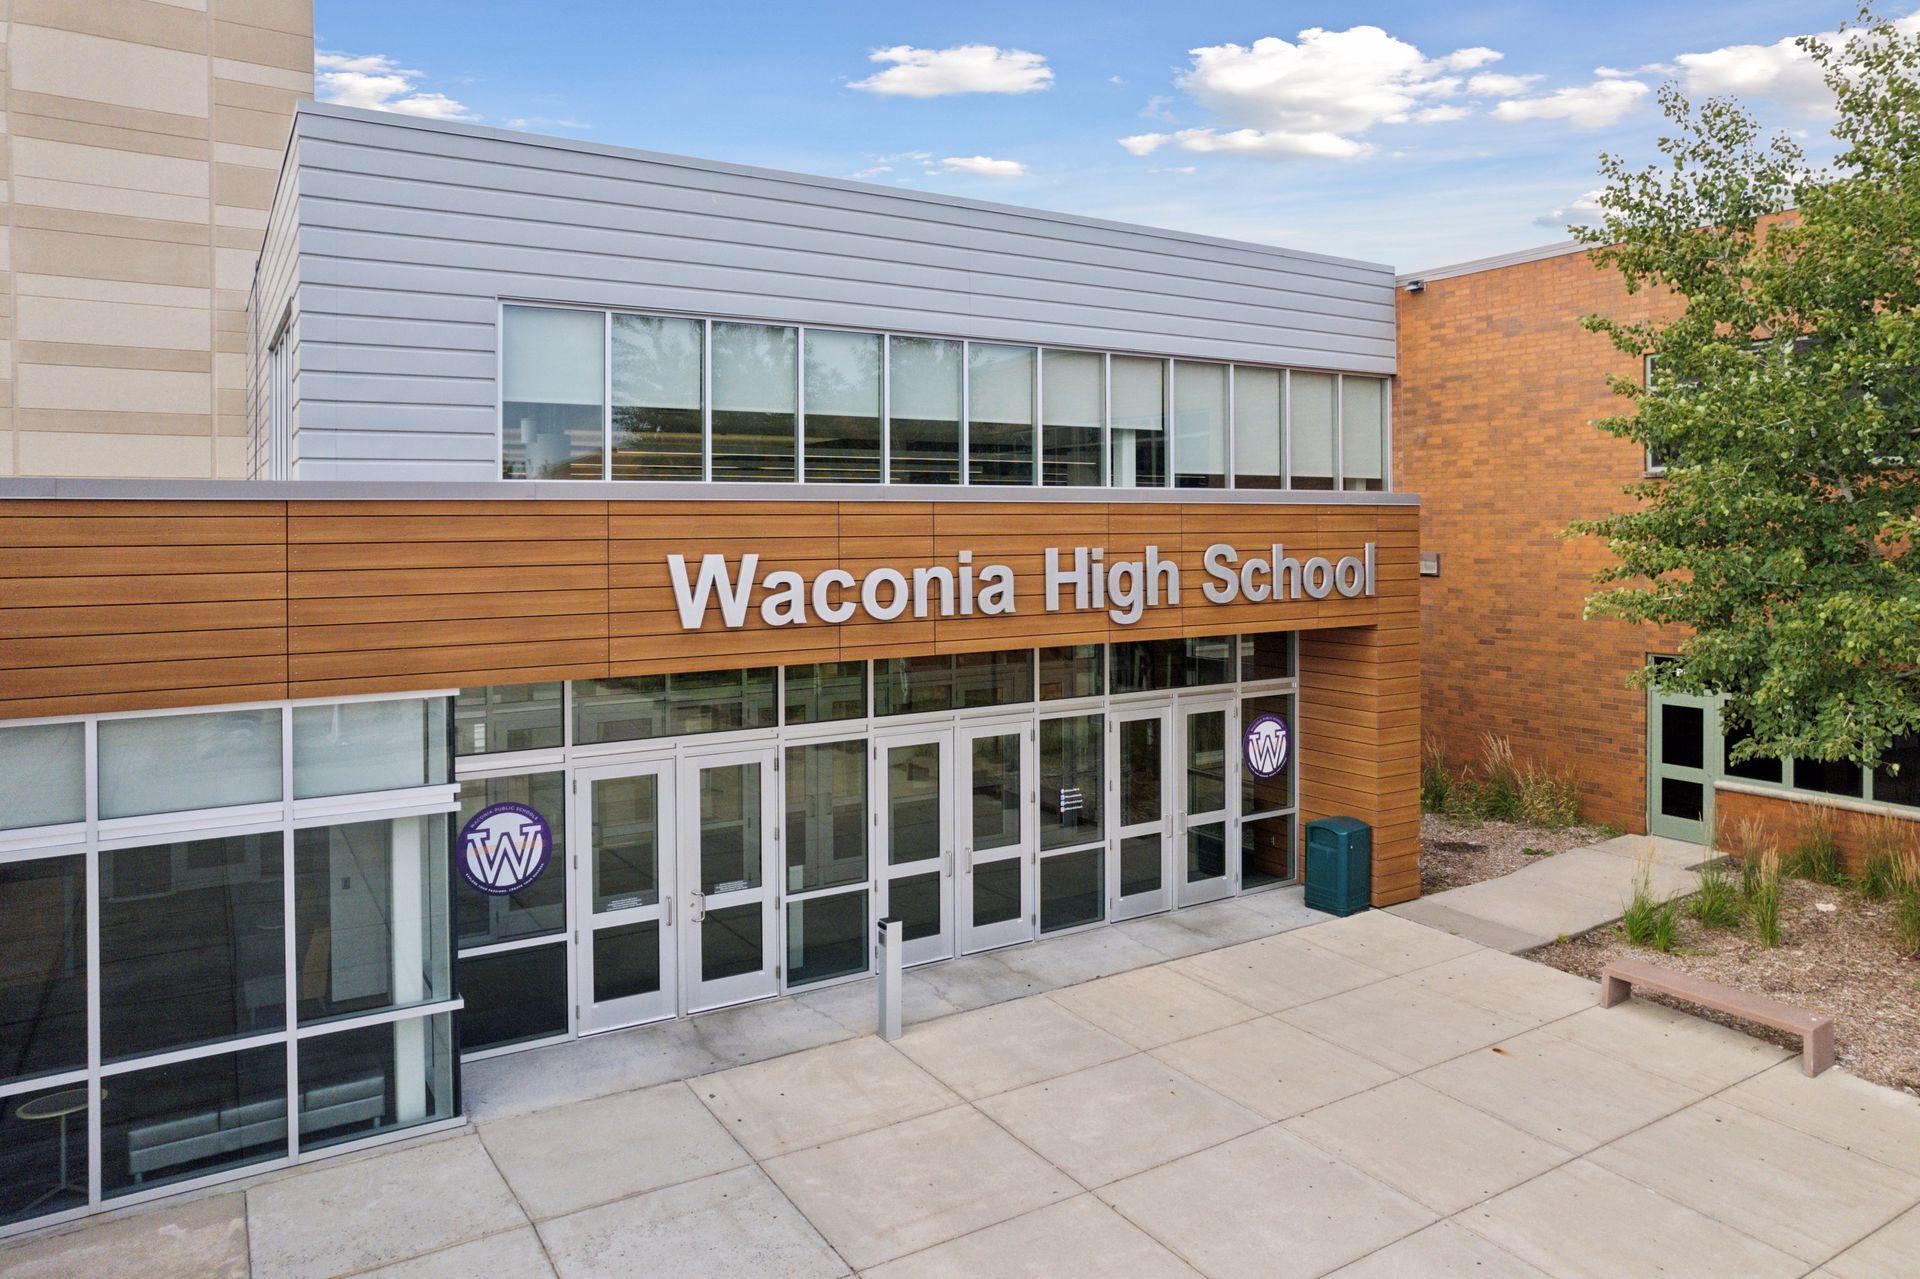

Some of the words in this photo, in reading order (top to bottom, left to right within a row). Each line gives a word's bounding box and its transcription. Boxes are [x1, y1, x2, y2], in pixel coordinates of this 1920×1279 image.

[667, 550, 1016, 630] Waconia
[1045, 545, 1180, 625] High
[1202, 542, 1376, 604] School
[1249, 730, 1286, 773] W
[470, 810, 493, 828] WACONIA
[516, 806, 538, 820] SCHOOLS
[467, 825, 541, 884] W
